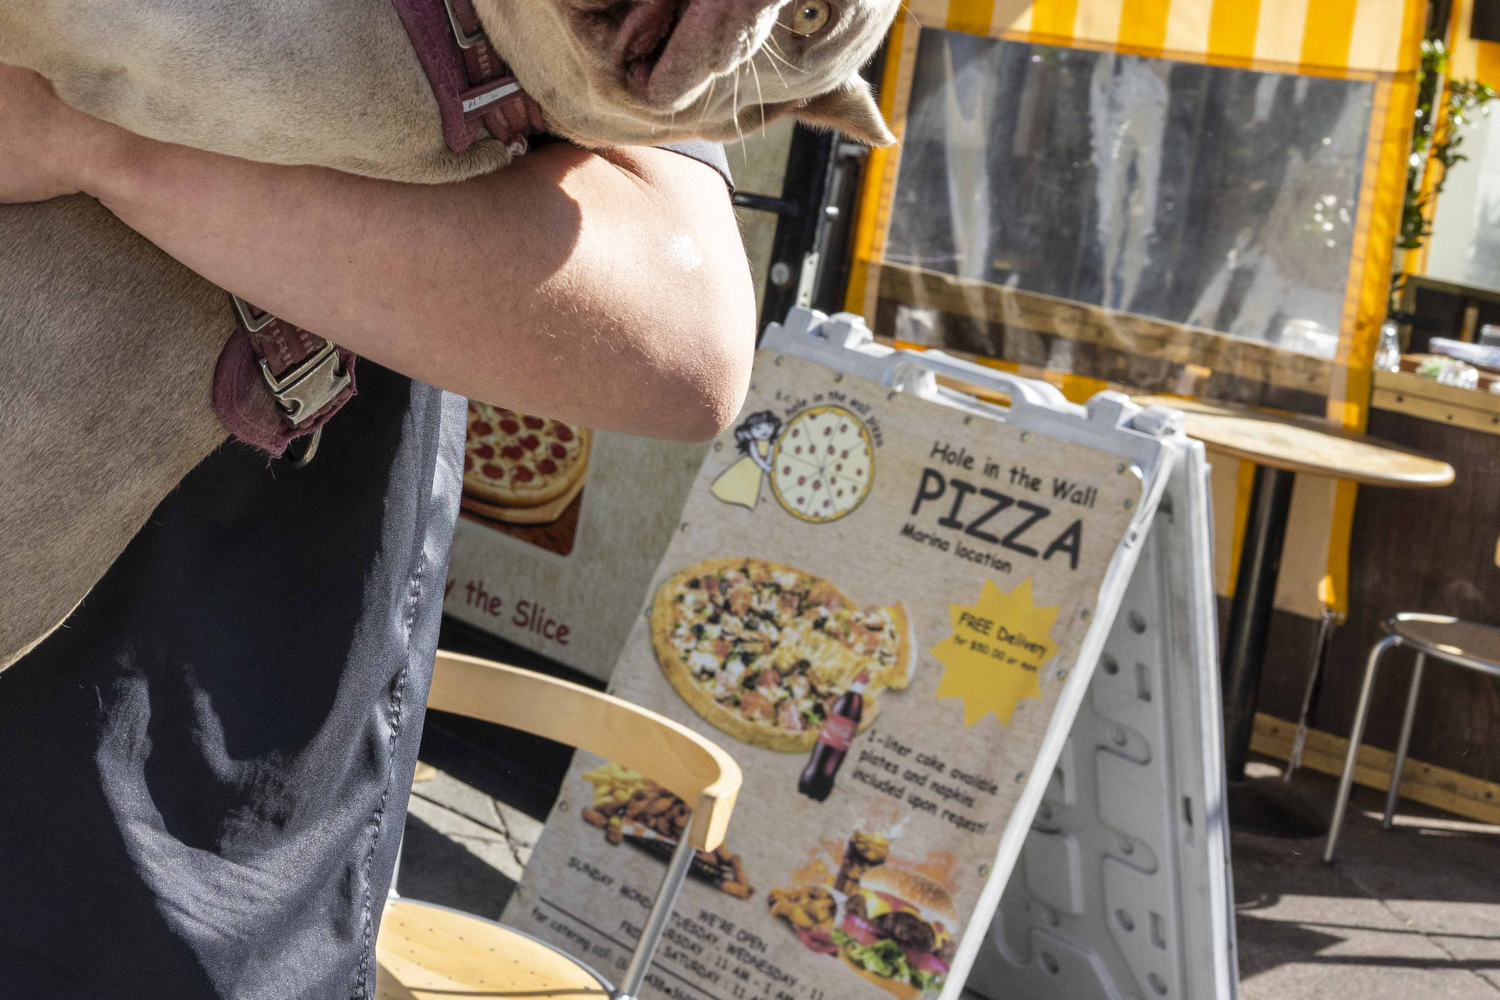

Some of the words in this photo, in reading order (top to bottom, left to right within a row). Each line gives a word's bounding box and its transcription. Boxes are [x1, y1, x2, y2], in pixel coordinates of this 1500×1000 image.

[813, 393, 824, 402] in
[828, 390, 847, 403] the
[850, 399, 872, 416] wall
[930, 441, 975, 471] Hole
[983, 455, 1001, 479] in
[1009, 464, 1041, 493] the
[1052, 476, 1098, 509] Wall
[910, 467, 1083, 570] PIZZA
[901, 522, 949, 553] Marina
[954, 542, 1012, 574] location
[466, 579, 503, 617] the
[512, 600, 570, 645] Slice
[957, 611, 994, 636] FREE
[996, 626, 1047, 659] Delivery
[859, 749, 899, 775] plates
[902, 769, 929, 787] and
[930, 780, 976, 809] napkins
[867, 729, 912, 757] 1-liter
[915, 753, 946, 773] coke
[951, 768, 998, 796] available
[851, 766, 906, 799] included
[907, 793, 938, 816] upon
[726, 942, 798, 988] WEDNESDAY
[736, 929, 768, 953] OPEN
